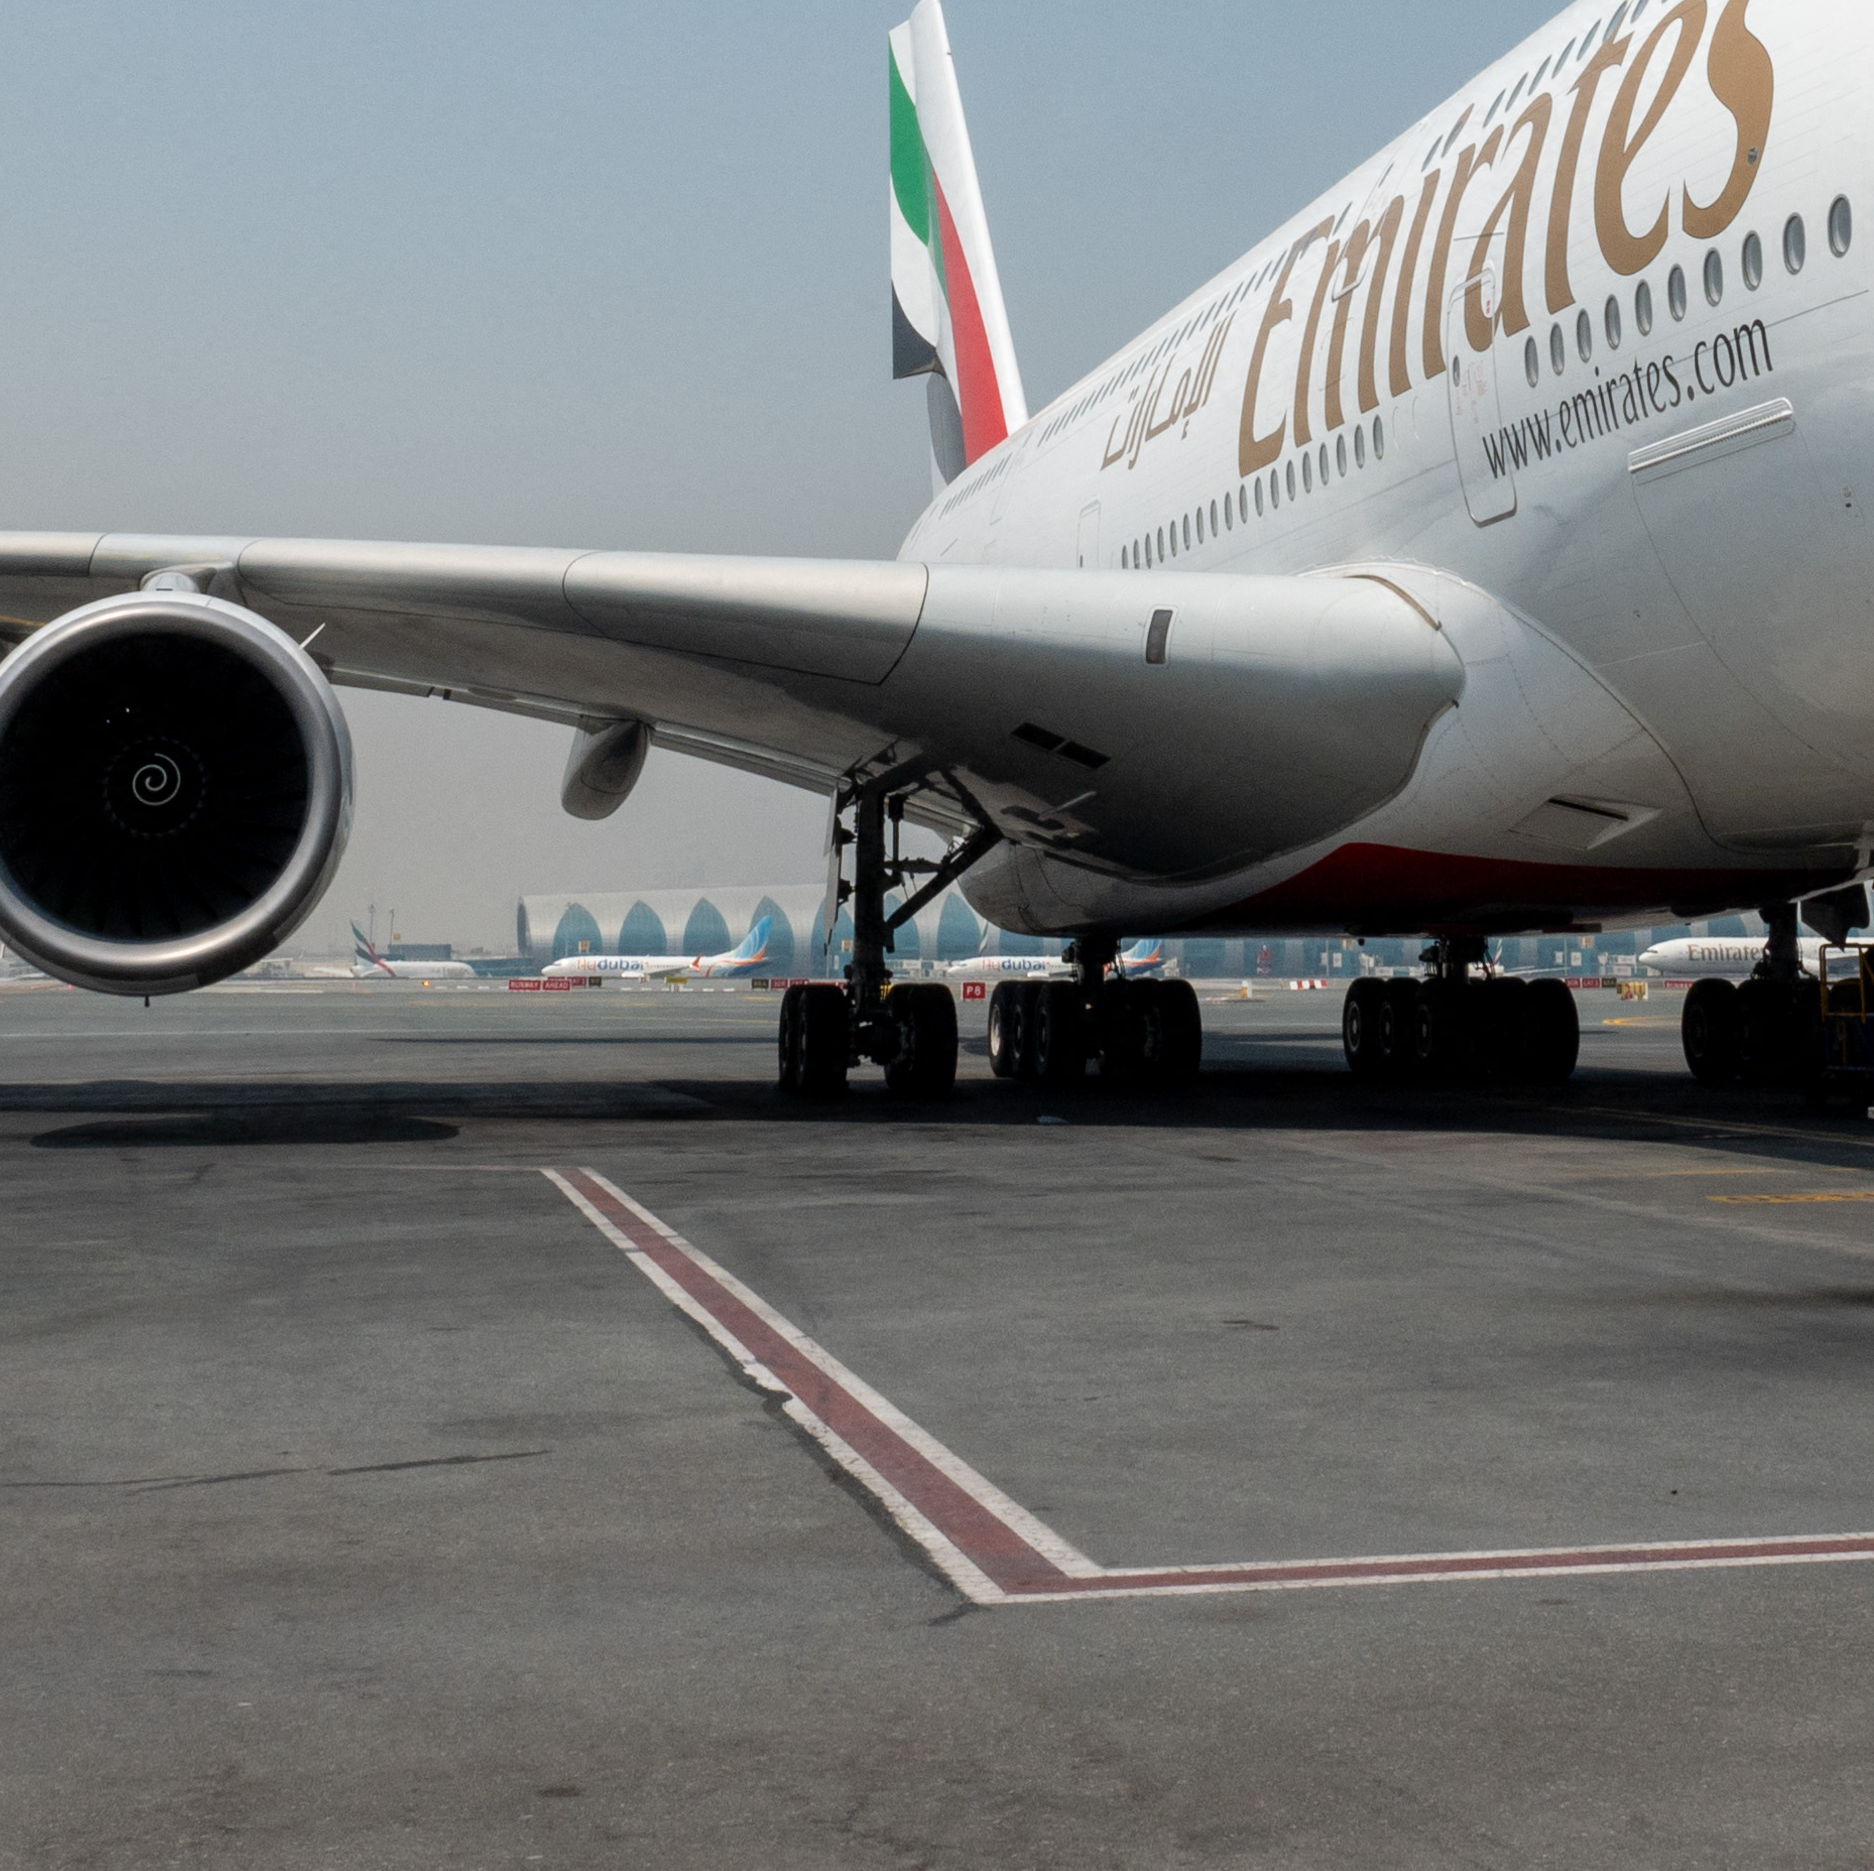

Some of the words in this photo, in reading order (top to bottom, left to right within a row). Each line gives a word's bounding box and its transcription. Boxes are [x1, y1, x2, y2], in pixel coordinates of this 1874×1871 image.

[1482, 318, 1774, 480] www.emirates.com
[577, 958, 644, 972] flydubai
[981, 959, 1046, 972] flydubai
[545, 980, 569, 989] AHEAD
